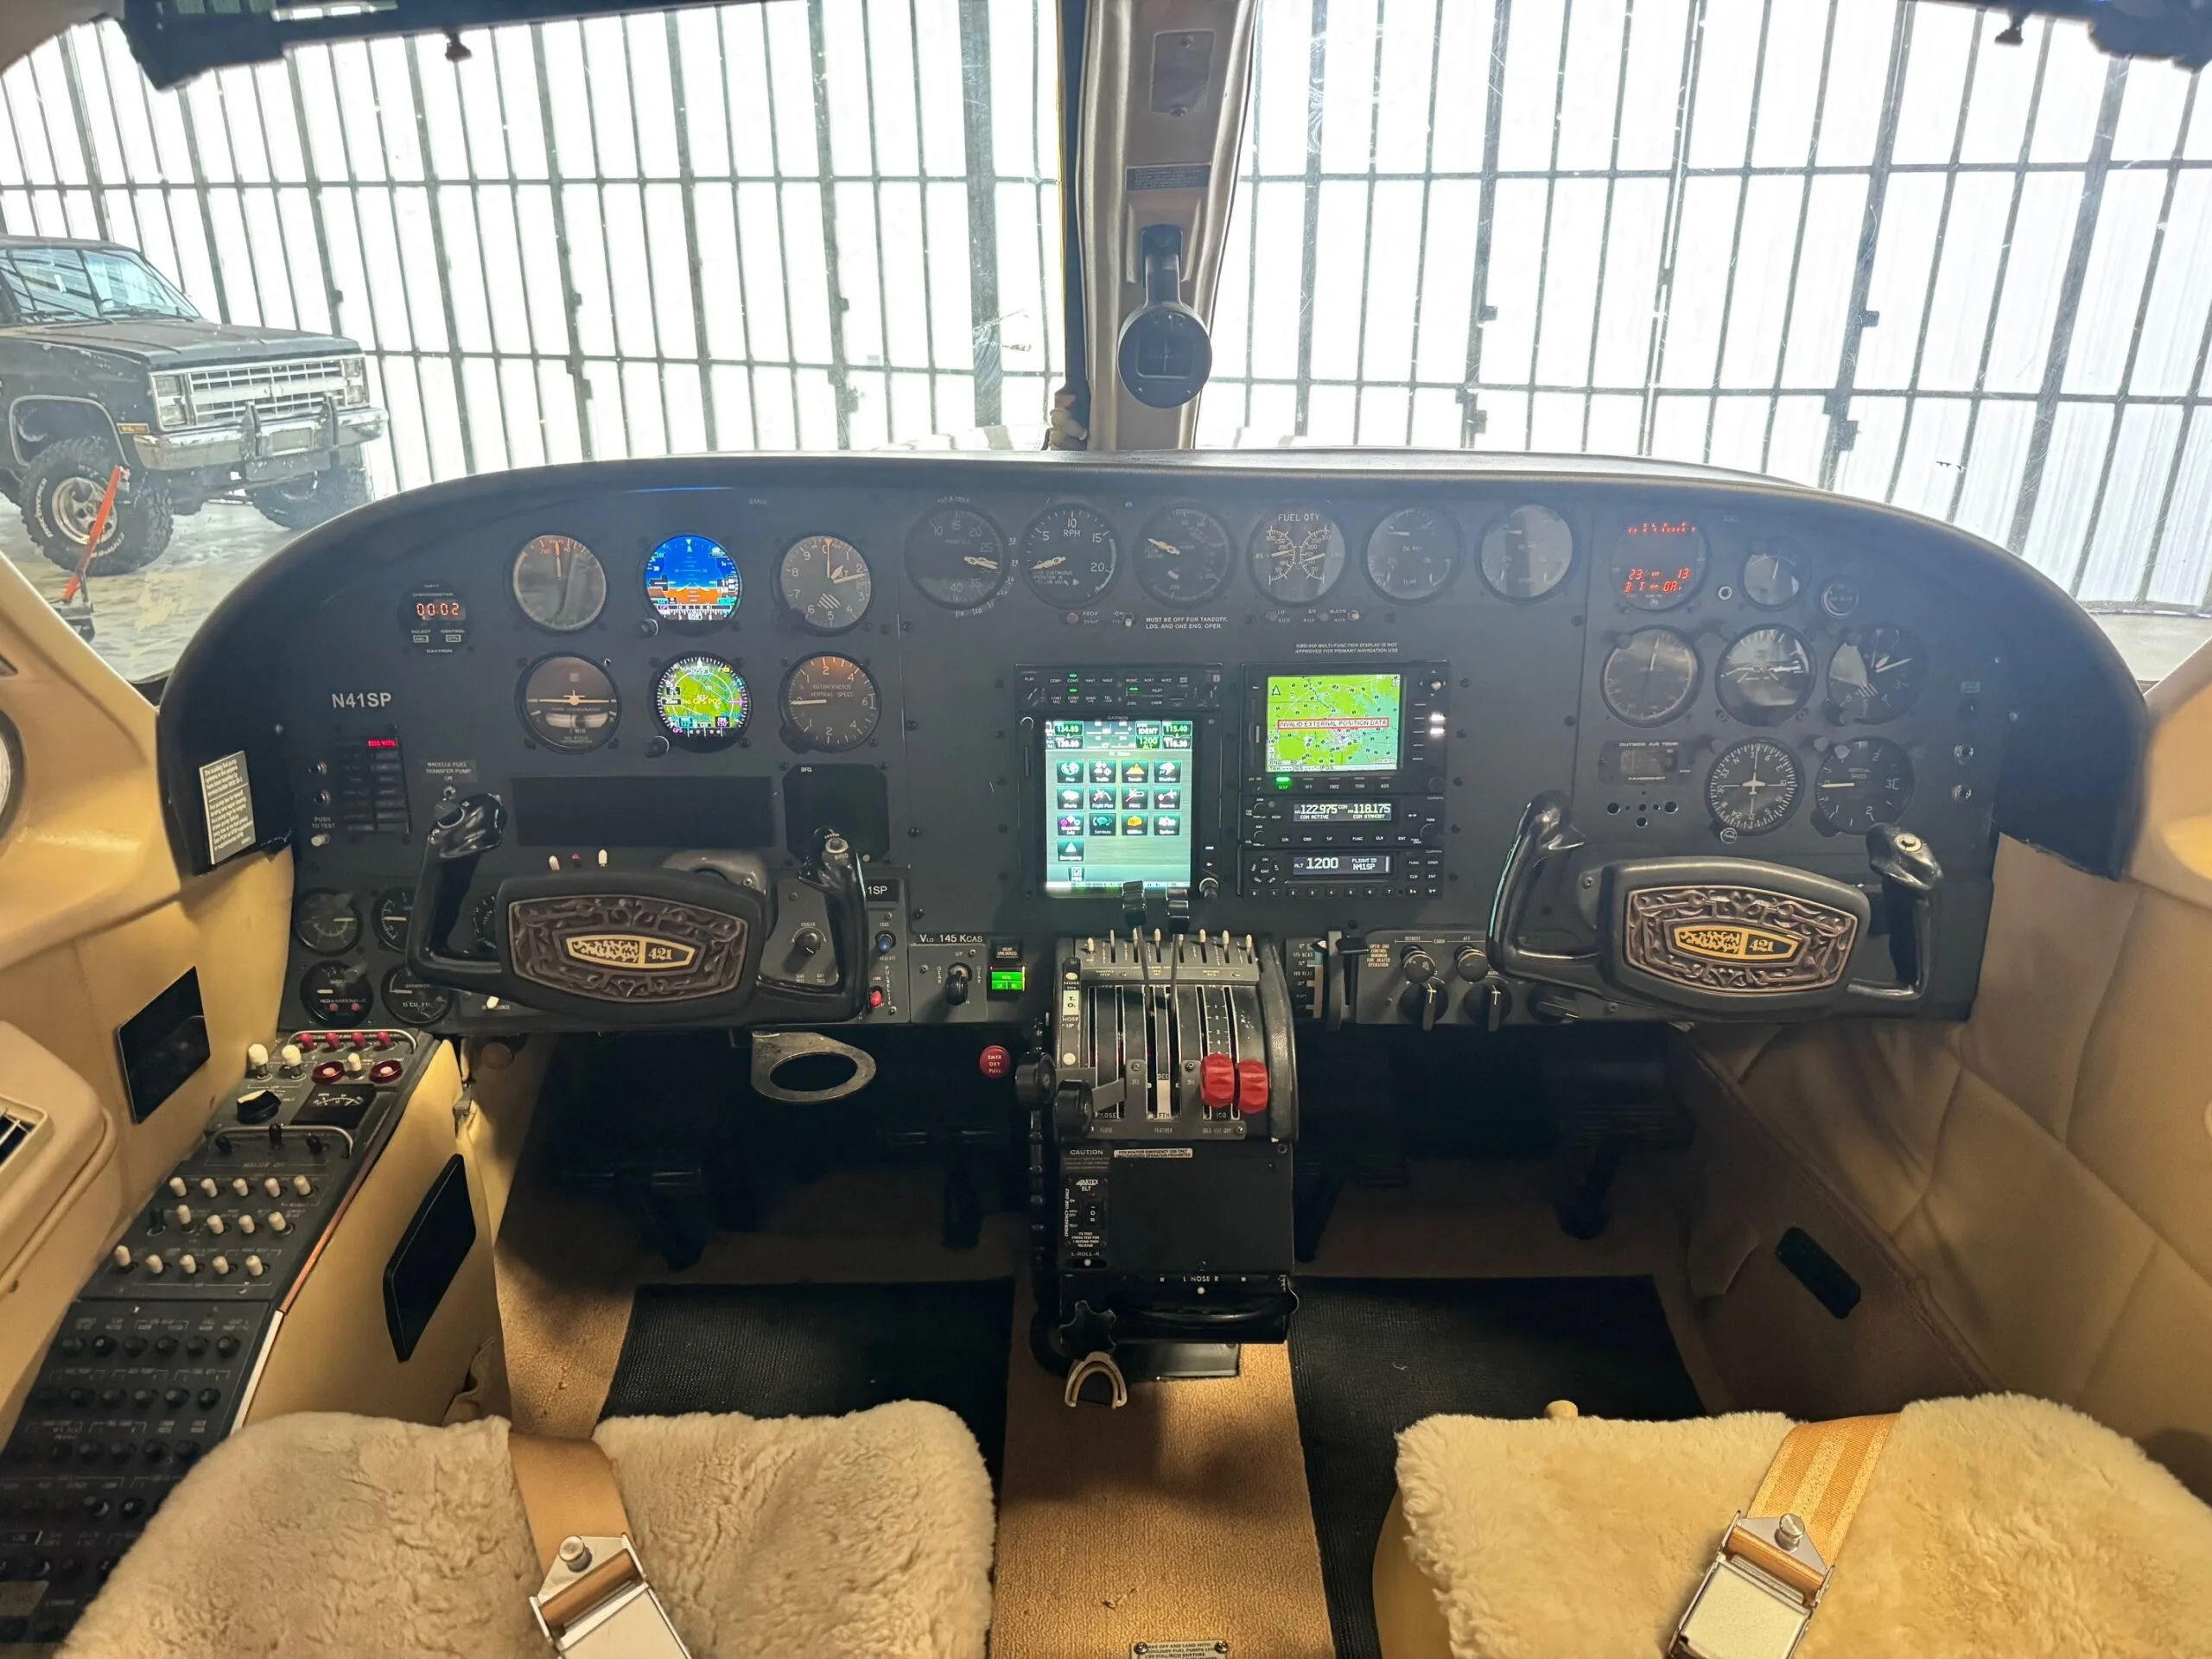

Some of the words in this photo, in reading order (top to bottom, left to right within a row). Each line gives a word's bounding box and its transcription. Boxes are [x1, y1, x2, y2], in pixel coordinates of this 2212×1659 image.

[1278, 513, 1301, 522] FUEL
[1303, 513, 1320, 522] QTY
[1067, 518, 1077, 529] 10
[1043, 531, 1050, 541] 5
[1092, 533, 1103, 543] 15
[803, 551, 810, 561] 9
[791, 568, 799, 577] 8
[855, 563, 862, 573] 2
[1090, 563, 1105, 572] 20
[794, 588, 801, 599] 7
[858, 592, 865, 601] 3
[807, 604, 815, 614] 6
[846, 605, 853, 613] 4
[827, 611, 835, 620] 5
[823, 665, 830, 676] 2
[847, 673, 855, 682] 4
[331, 692, 392, 709] N41SP
[862, 697, 869, 707] 6
[849, 720, 857, 728] 4
[825, 727, 833, 736] 2
[1872, 753, 1880, 761] 2
[1885, 779, 1891, 789] 3
[1300, 804, 1338, 815] 122.975
[1353, 803, 1391, 814] 118.175
[1866, 805, 1873, 815] 2
[1306, 856, 1339, 869] 1200
[939, 934, 957, 943] 145
[1749, 938, 1775, 952] 421
[648, 948, 672, 961] 421
